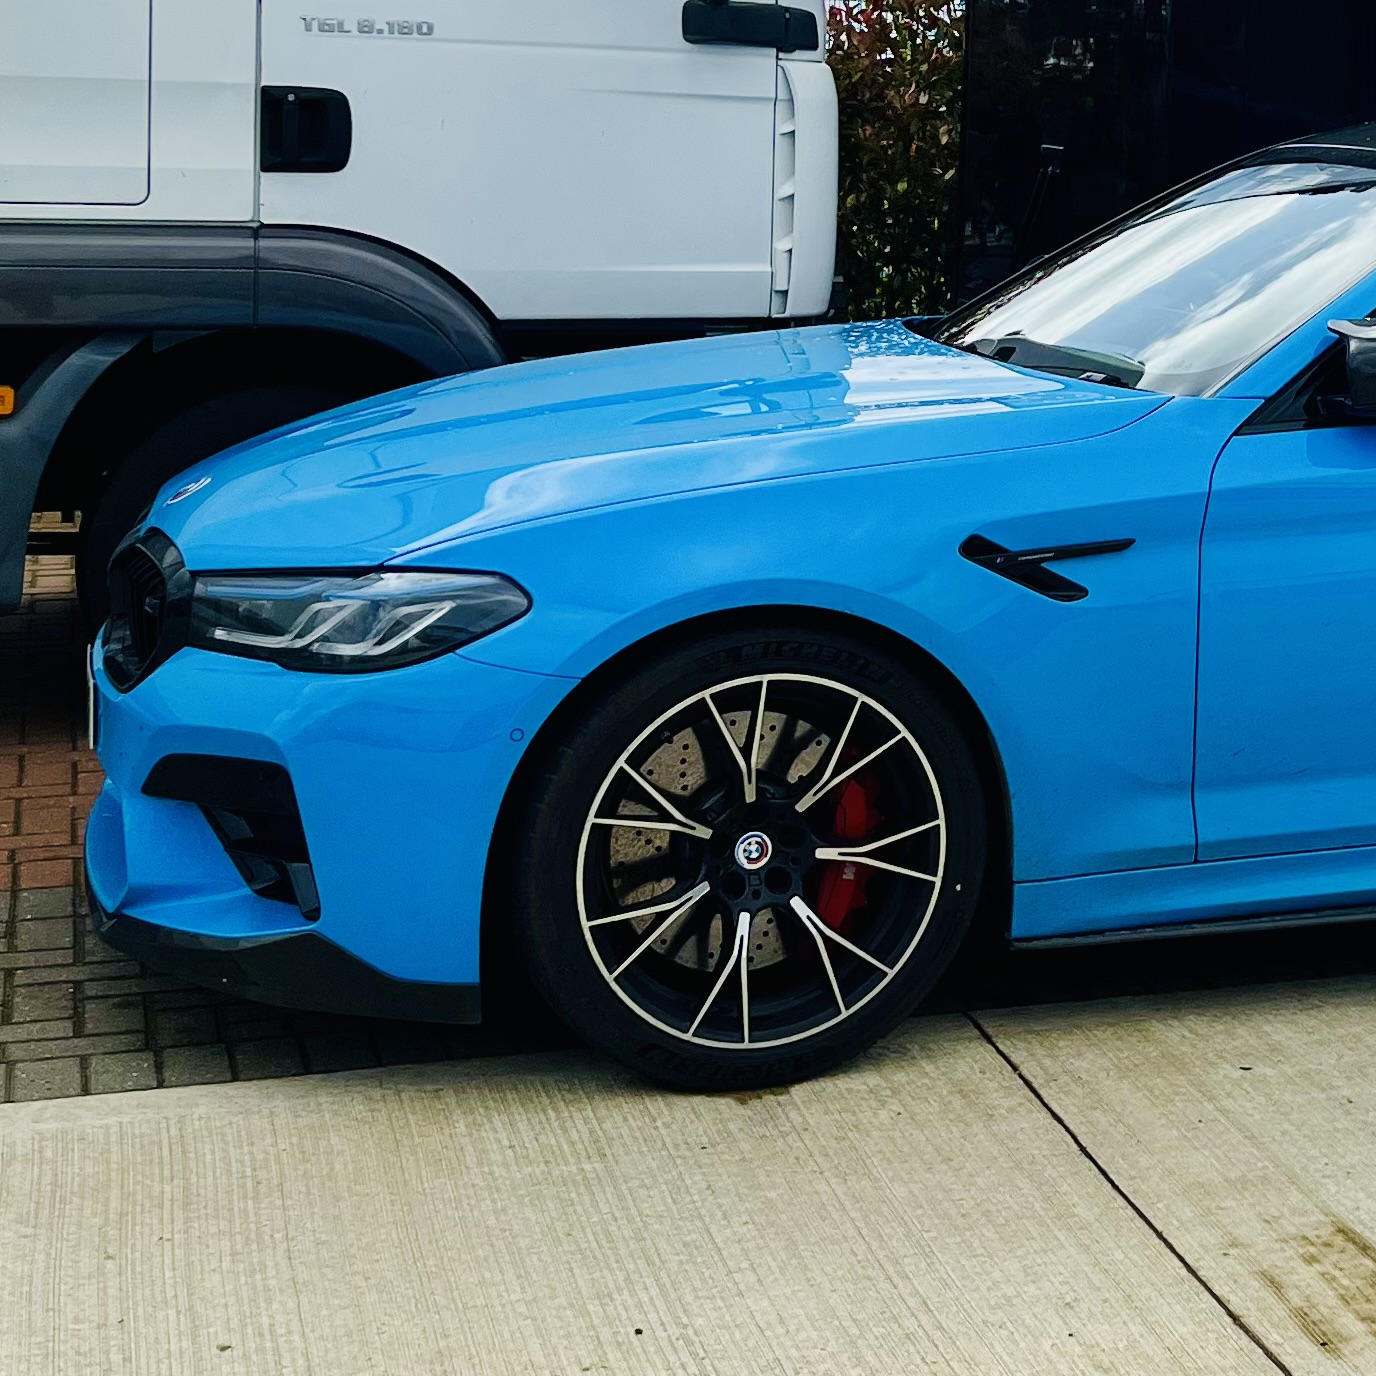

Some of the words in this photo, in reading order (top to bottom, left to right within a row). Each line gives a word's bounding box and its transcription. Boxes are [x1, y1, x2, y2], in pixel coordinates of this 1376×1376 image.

[300, 15, 351, 33] TGL
[357, 19, 435, 36] 8.180
[738, 640, 889, 682] MICHELIN
